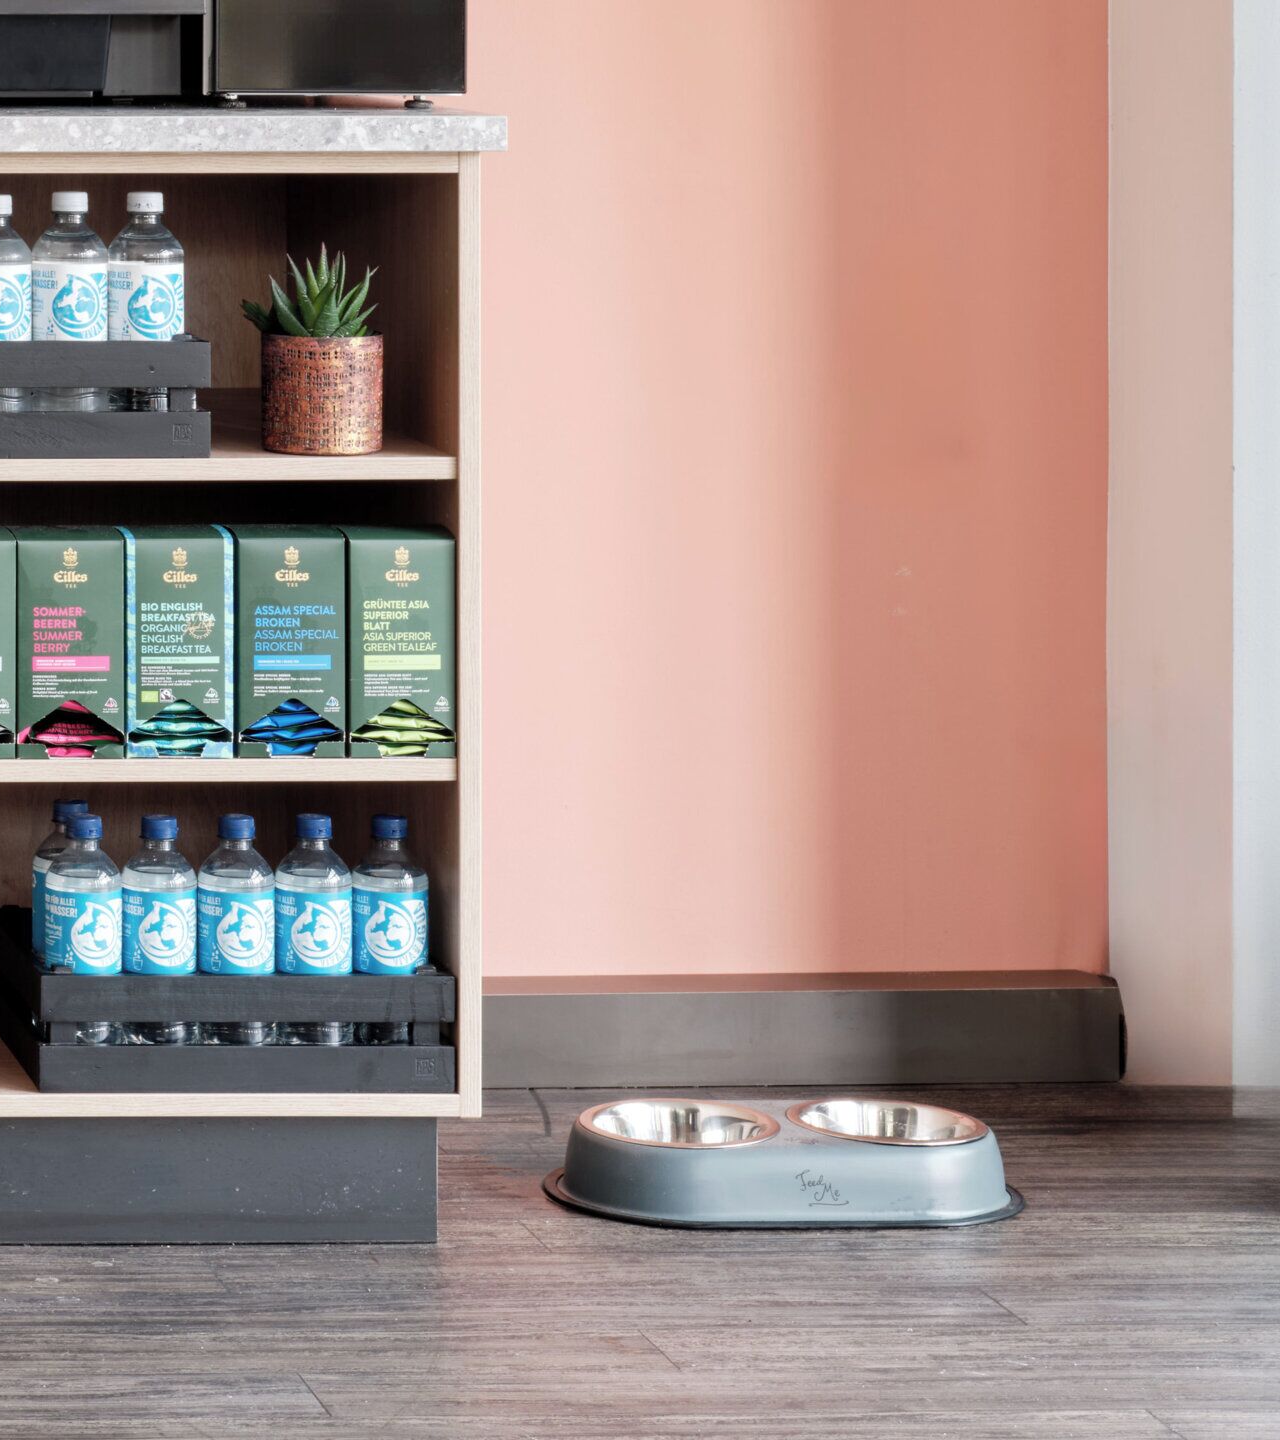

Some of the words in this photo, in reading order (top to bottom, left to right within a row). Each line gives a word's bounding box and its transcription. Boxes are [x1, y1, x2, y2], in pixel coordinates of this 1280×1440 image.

[53, 571, 88, 584] Eilles
[163, 570, 197, 583] Eilles
[275, 569, 309, 582] Eilles
[385, 569, 419, 582] Eilles
[141, 603, 159, 612] BIO
[161, 602, 203, 612] ENGLISH
[363, 598, 406, 609] GRÜNTEE
[408, 600, 430, 609] ASIA
[33, 606, 86, 617] SOMMER-
[255, 605, 293, 615] ASSAM
[295, 605, 336, 615] SPECIAL
[141, 613, 196, 622] BREAKFAST
[198, 613, 215, 622] TEA
[363, 611, 409, 620] SUPERIOR
[33, 618, 77, 629] BEEREN
[255, 617, 300, 627] BROKEN
[363, 621, 390, 630] BLATT
[141, 623, 187, 633] ORGANIC
[33, 630, 83, 641] SUMMER
[141, 634, 183, 643] ENGLISH
[254, 630, 293, 640] ASSAM
[295, 629, 339, 639] SPECIAL
[363, 632, 384, 641] ASIA
[386, 632, 432, 641] SUPERIOR
[33, 643, 70, 653] BERRY
[141, 645, 192, 654] BREAKFAST
[194, 644, 211, 653] TEA
[255, 642, 302, 652] BROKEN
[363, 642, 396, 652] GREEN
[397, 642, 415, 652] TEA
[415, 642, 437, 651] LEAF
[59, 898, 75, 907] ALLE!
[795, 1169, 824, 1193] Feed
[813, 1182, 841, 1203] Me
